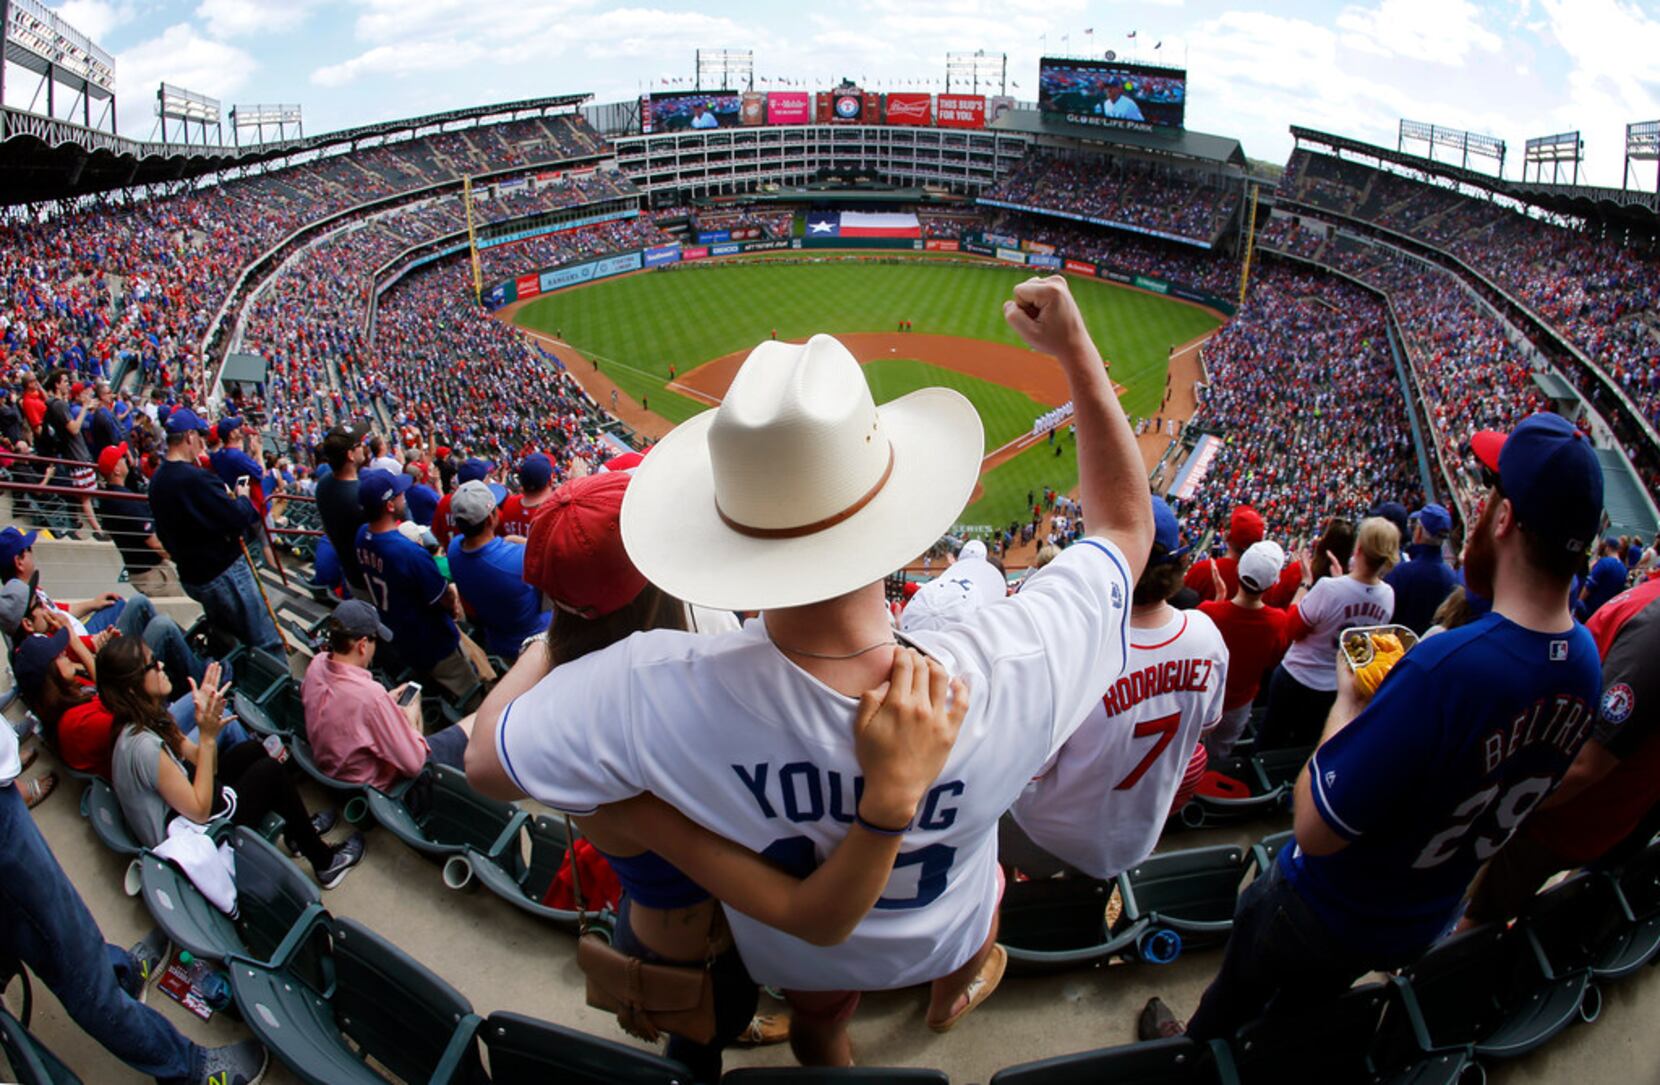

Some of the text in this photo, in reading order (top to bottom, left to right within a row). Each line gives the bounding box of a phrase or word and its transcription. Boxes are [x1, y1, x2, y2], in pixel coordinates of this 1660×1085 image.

[939, 99, 983, 111] THIS BUD'S
[939, 110, 956, 120] FOR
[1103, 118, 1124, 129] LIFE
[1126, 121, 1152, 132] PARK
[363, 573, 388, 612] 17
[1102, 659, 1213, 718] RODRIGUEZ
[1112, 710, 1182, 790] 7
[1485, 694, 1593, 774] BELTRE
[730, 761, 966, 831] YOUG
[1411, 776, 1554, 869] 29
